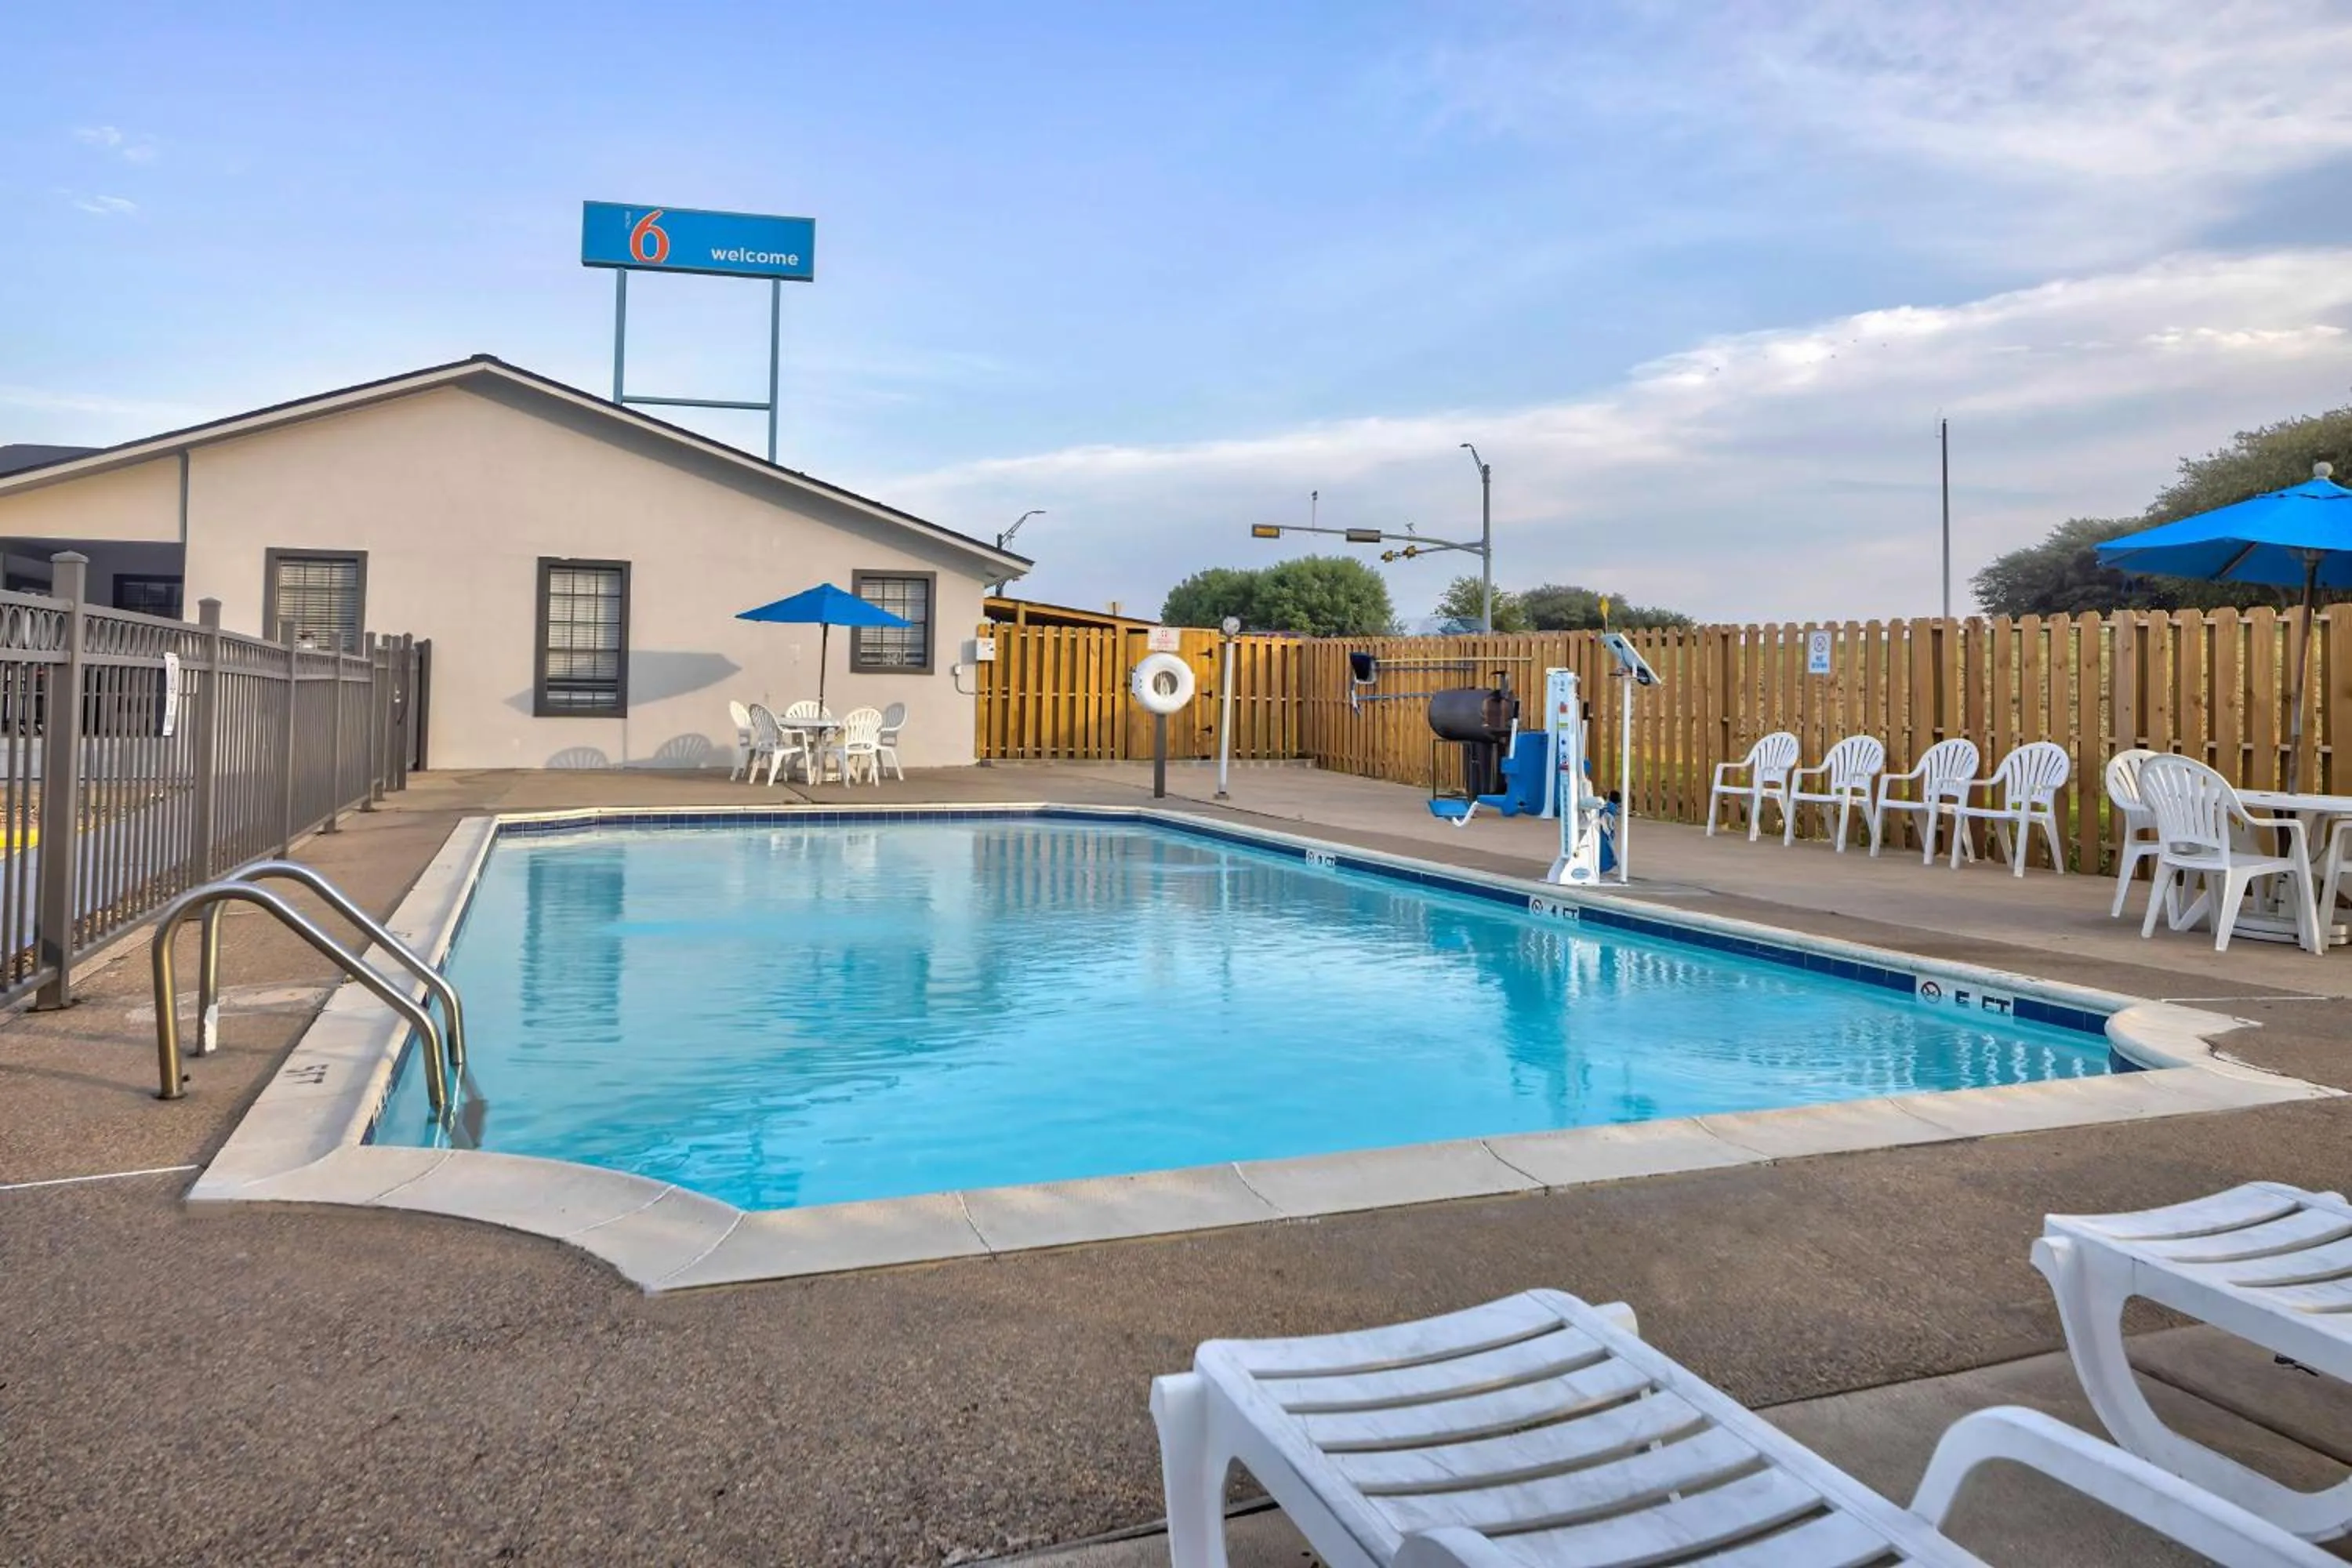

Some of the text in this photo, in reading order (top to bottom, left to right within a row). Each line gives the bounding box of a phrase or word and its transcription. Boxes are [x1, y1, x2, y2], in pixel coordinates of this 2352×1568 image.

[630, 209, 670, 263] 6
[710, 247, 799, 266] welcome
[1982, 995, 2010, 1014] FT
